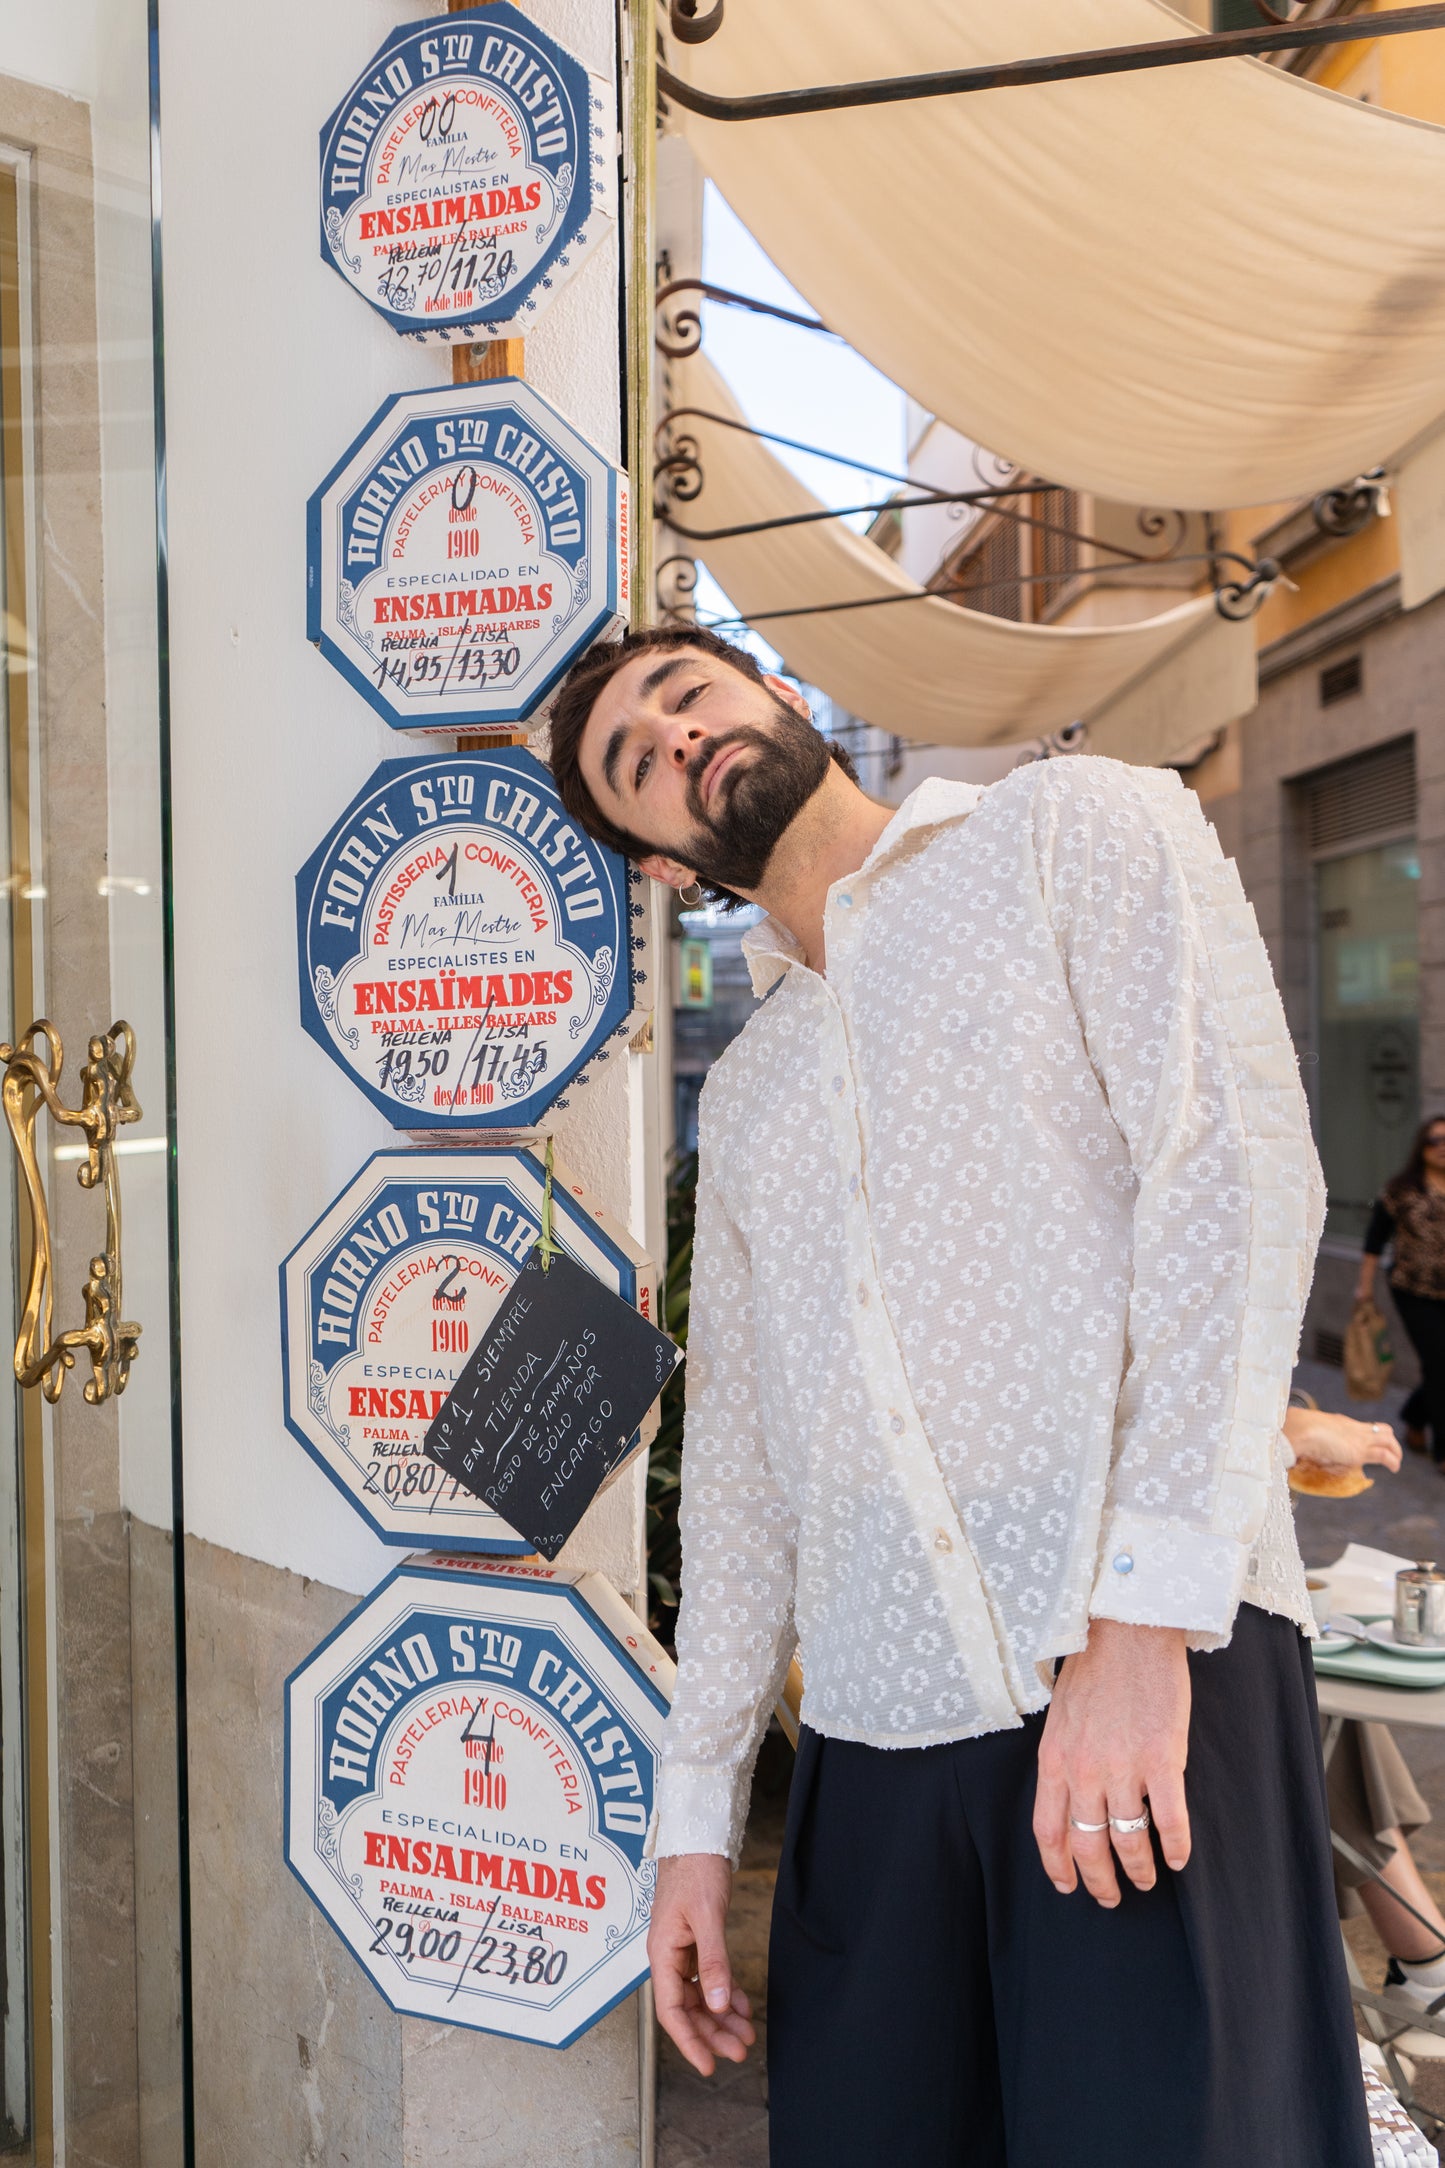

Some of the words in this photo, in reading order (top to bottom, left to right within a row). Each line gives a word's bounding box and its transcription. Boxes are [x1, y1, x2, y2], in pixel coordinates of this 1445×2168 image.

[331, 58, 413, 196] HORNO
[479, 36, 567, 156] CRISTO
[377, 95, 441, 184] PASTELERIA
[455, 89, 523, 158] CONFITERIA
[420, 95, 456, 141] 00
[426, 131, 468, 147] FAMILIA
[397, 153, 436, 186] Mas
[441, 145, 498, 179] Mestre
[387, 179, 486, 205] ESPECIALISTAS
[492, 173, 509, 186] EN
[359, 181, 541, 240] ENSAIMADAS
[373, 239, 417, 256] PALMA
[428, 232, 465, 248] ILLES
[469, 220, 528, 240] BALEARS
[388, 243, 441, 265] RELLENA
[424, 294, 450, 313] desde
[453, 289, 473, 309] 1910
[347, 436, 429, 566] HORNO
[494, 424, 580, 546] CRISTO
[392, 477, 455, 558] PASTELERIA
[470, 473, 535, 545] CONFITERIA
[447, 528, 480, 559] 1910
[387, 567, 509, 588] ESPECIALIDAD
[518, 565, 540, 576] EN
[373, 583, 553, 624] ENSAIMADAS
[381, 635, 439, 652] RELLENA
[386, 629, 426, 640] PALMA
[438, 625, 472, 637] ISLAS
[476, 619, 540, 633] BALEARES
[320, 802, 405, 932] FORN
[484, 779, 604, 922] CRISTO
[373, 846, 448, 945] PASTISSERIA
[464, 843, 549, 933] CONFITERIA
[400, 912, 447, 949] Mas
[453, 910, 522, 946] Mestre
[388, 951, 507, 971] ESPECIALISTES
[514, 950, 535, 963] EN
[353, 969, 573, 1016] ENSAÏMADES
[371, 1020, 425, 1034] PALMA
[437, 1016, 483, 1031] ILLES
[486, 1011, 557, 1028] BALEARS
[381, 1029, 452, 1047] RELLENA
[470, 1082, 494, 1105] 1910
[317, 1203, 409, 1347] HORNO
[433, 1254, 467, 1302] 2
[368, 1256, 440, 1343] PASTELERIA
[456, 1256, 512, 1295] CONFI
[431, 1319, 469, 1353] 1910
[476, 1293, 533, 1382] SIEMPRE
[363, 1364, 459, 1381] ESPECIAL
[573, 1365, 602, 1405] POR
[363, 1427, 410, 1441] PALMA
[485, 1454, 522, 1506] RESTO
[521, 1424, 540, 1451] DE
[540, 1328, 596, 1421] TAMAÑOS
[462, 1438, 485, 1473] EN
[540, 1400, 613, 1511] ENCARGO
[432, 1558, 557, 1579] ENSAIMADAS
[328, 1632, 439, 1787] HORNO
[528, 1650, 647, 1837] CRISTO
[389, 1696, 474, 1786] PASTELERIA
[478, 1696, 489, 1714] Y
[494, 1701, 583, 1815] CONFITERIA
[463, 1767, 507, 1811] 1910
[382, 1809, 547, 1853] ESPECIALIDAD
[560, 1843, 589, 1862] EN
[363, 1831, 607, 1910] ENSAIMADAS
[379, 1880, 434, 1901] PALMA
[449, 1892, 496, 1914] ISLAS
[501, 1905, 589, 1934] BALEARES
[383, 1896, 460, 1923] RELLENA
